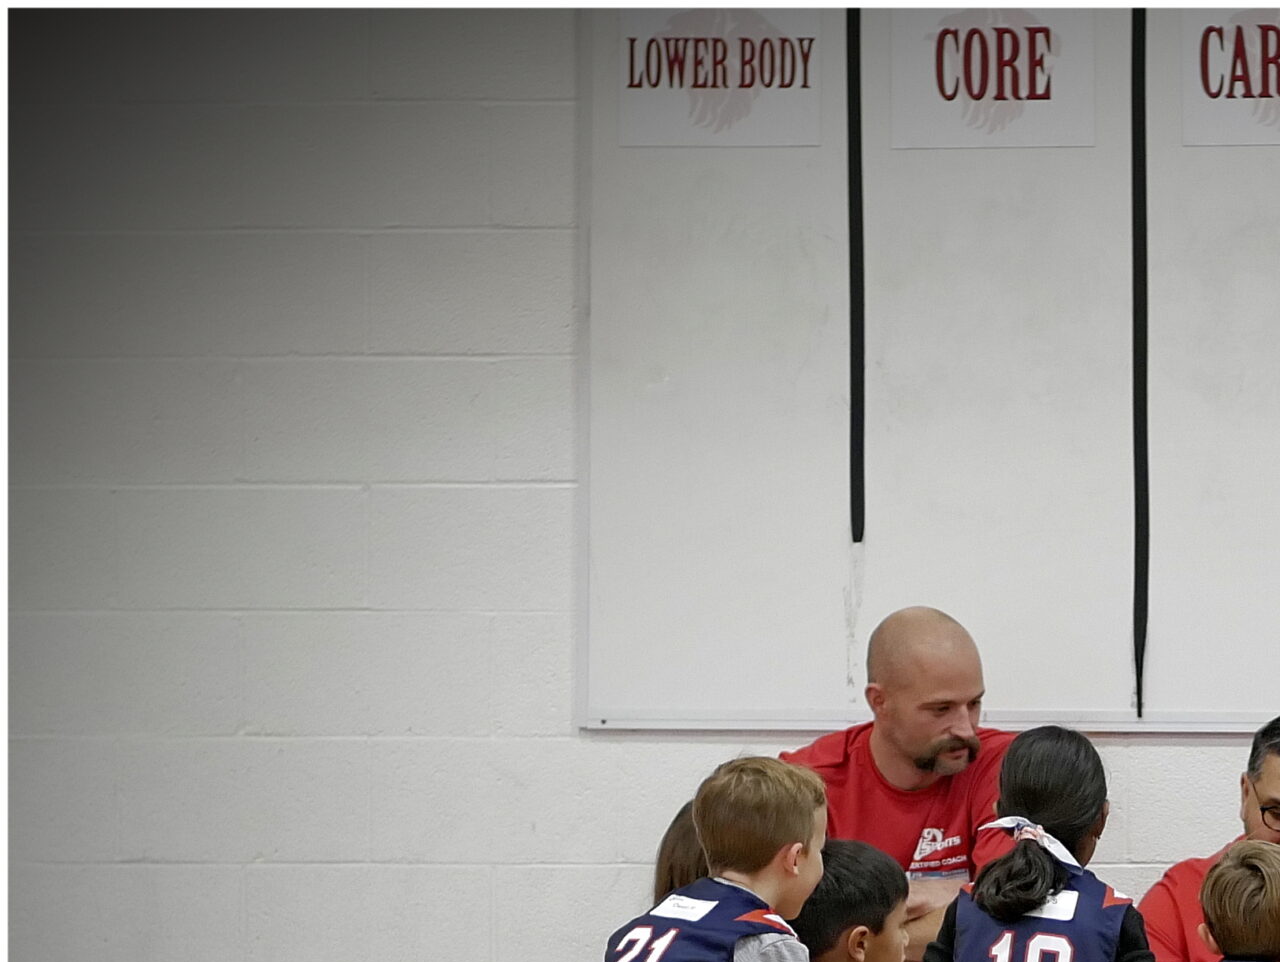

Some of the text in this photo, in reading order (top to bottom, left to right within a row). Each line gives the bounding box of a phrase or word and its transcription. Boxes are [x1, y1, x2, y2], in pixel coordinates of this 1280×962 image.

[627, 37, 815, 89] LOWER BODY
[935, 26, 1052, 101] CORE
[942, 856, 967, 866] COACH
